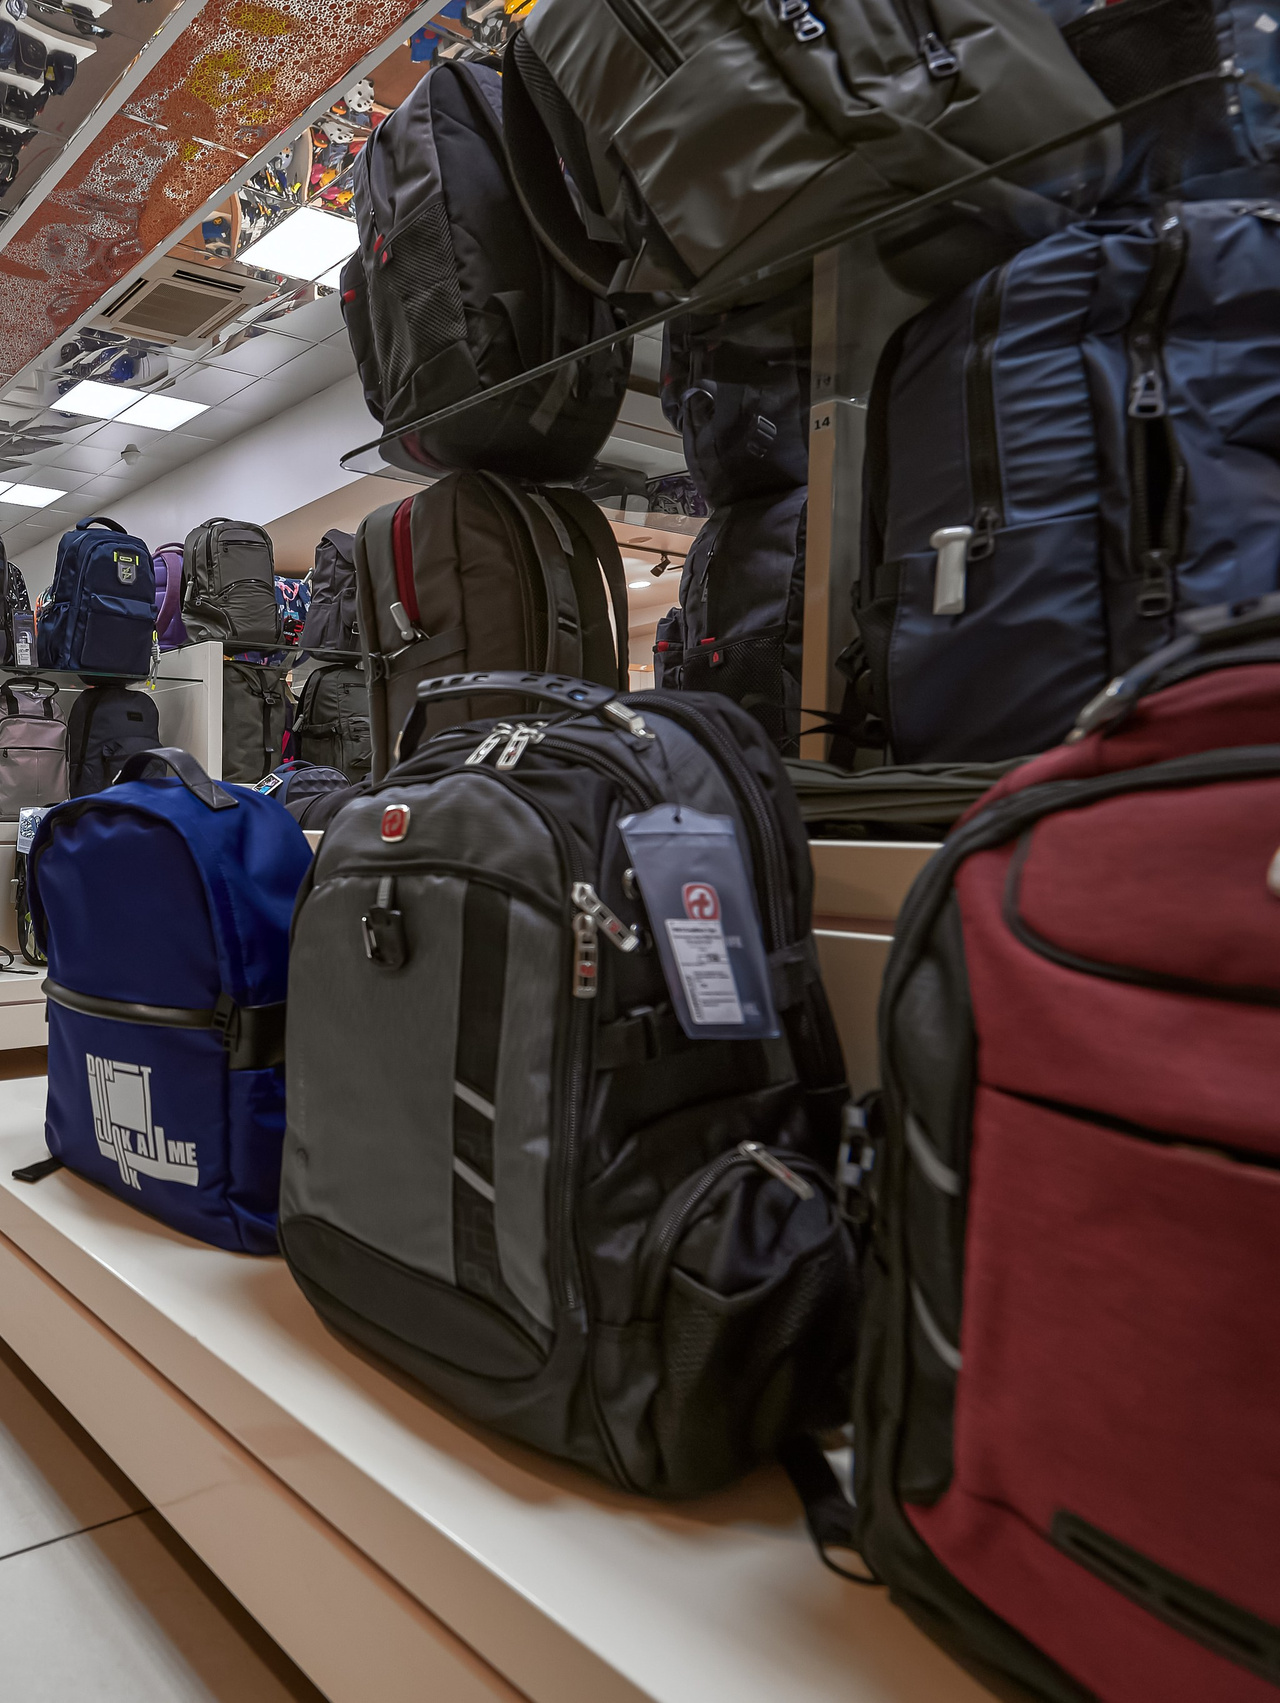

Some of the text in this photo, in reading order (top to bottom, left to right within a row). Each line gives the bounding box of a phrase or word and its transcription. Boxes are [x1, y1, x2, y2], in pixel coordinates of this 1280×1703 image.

[814, 416, 830, 430] 14
[137, 1132, 156, 1159] AT
[167, 1139, 197, 1165] ME
